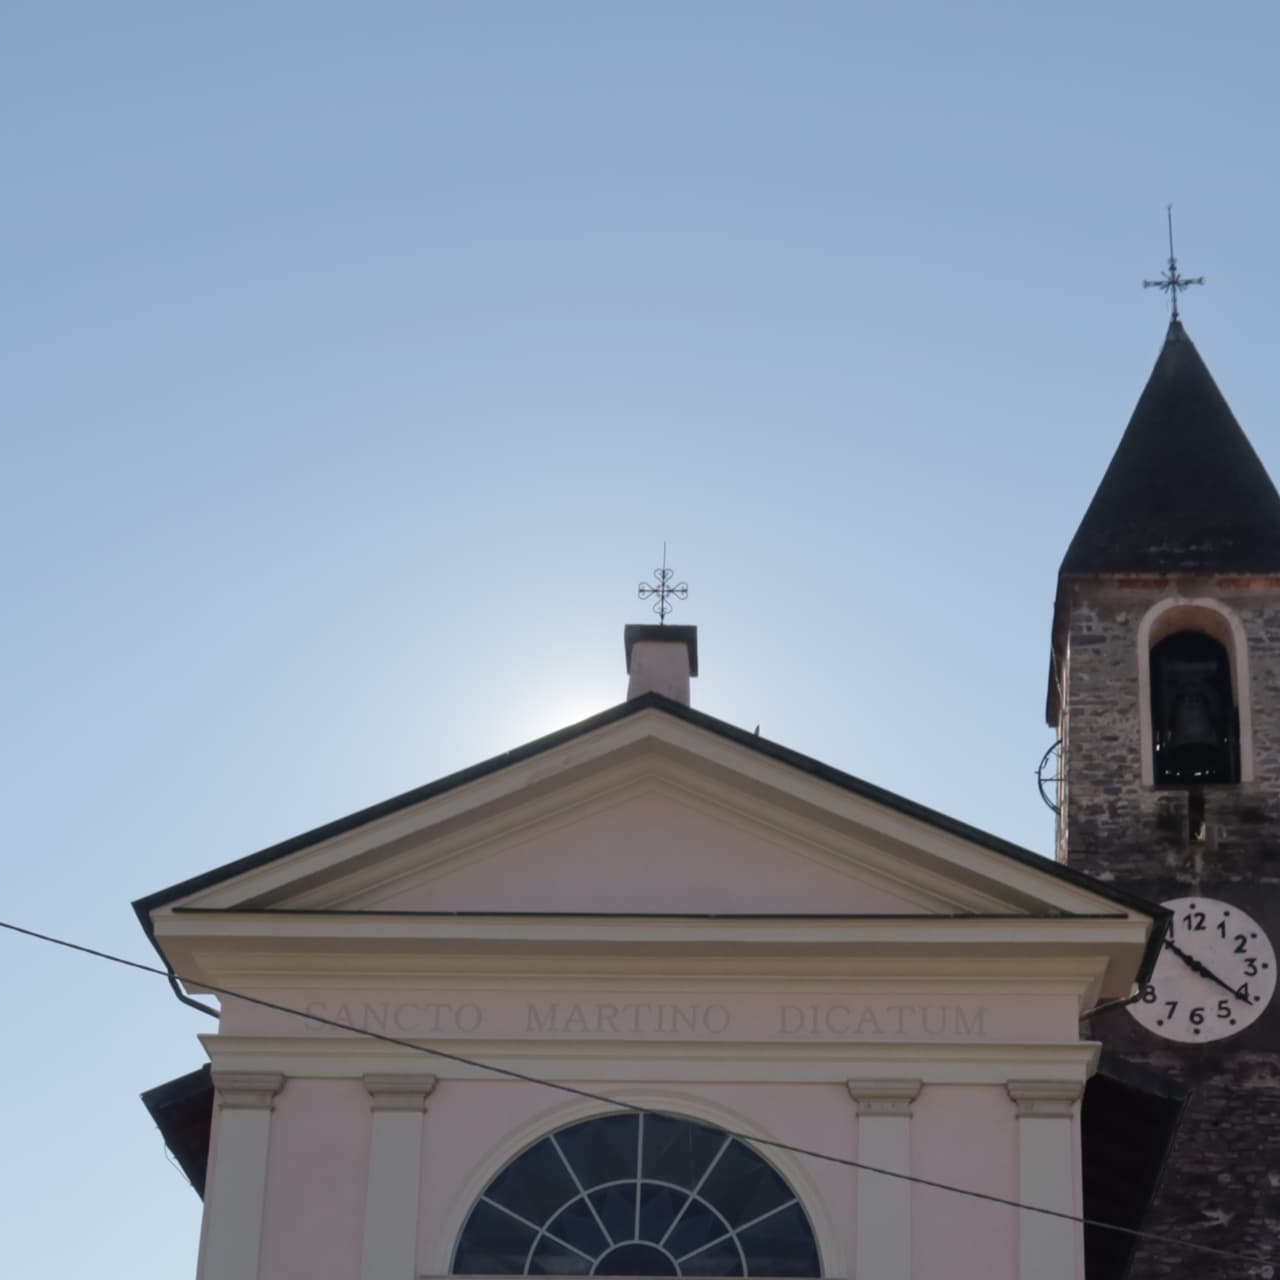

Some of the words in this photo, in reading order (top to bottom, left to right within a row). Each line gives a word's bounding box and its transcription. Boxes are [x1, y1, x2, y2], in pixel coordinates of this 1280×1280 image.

[1183, 912, 1207, 931] 12
[1216, 920, 1227, 939] 1
[1233, 935, 1248, 954] 2
[1243, 957, 1258, 977] 3
[1142, 985, 1157, 1004] 8
[303, 1000, 484, 1034] SANCTO
[524, 1002, 732, 1036] MARTINO
[776, 1003, 989, 1038] DICATUM
[1164, 1001, 1179, 1020] 7
[1189, 1007, 1205, 1025] 6
[1216, 1000, 1232, 1019] 5
